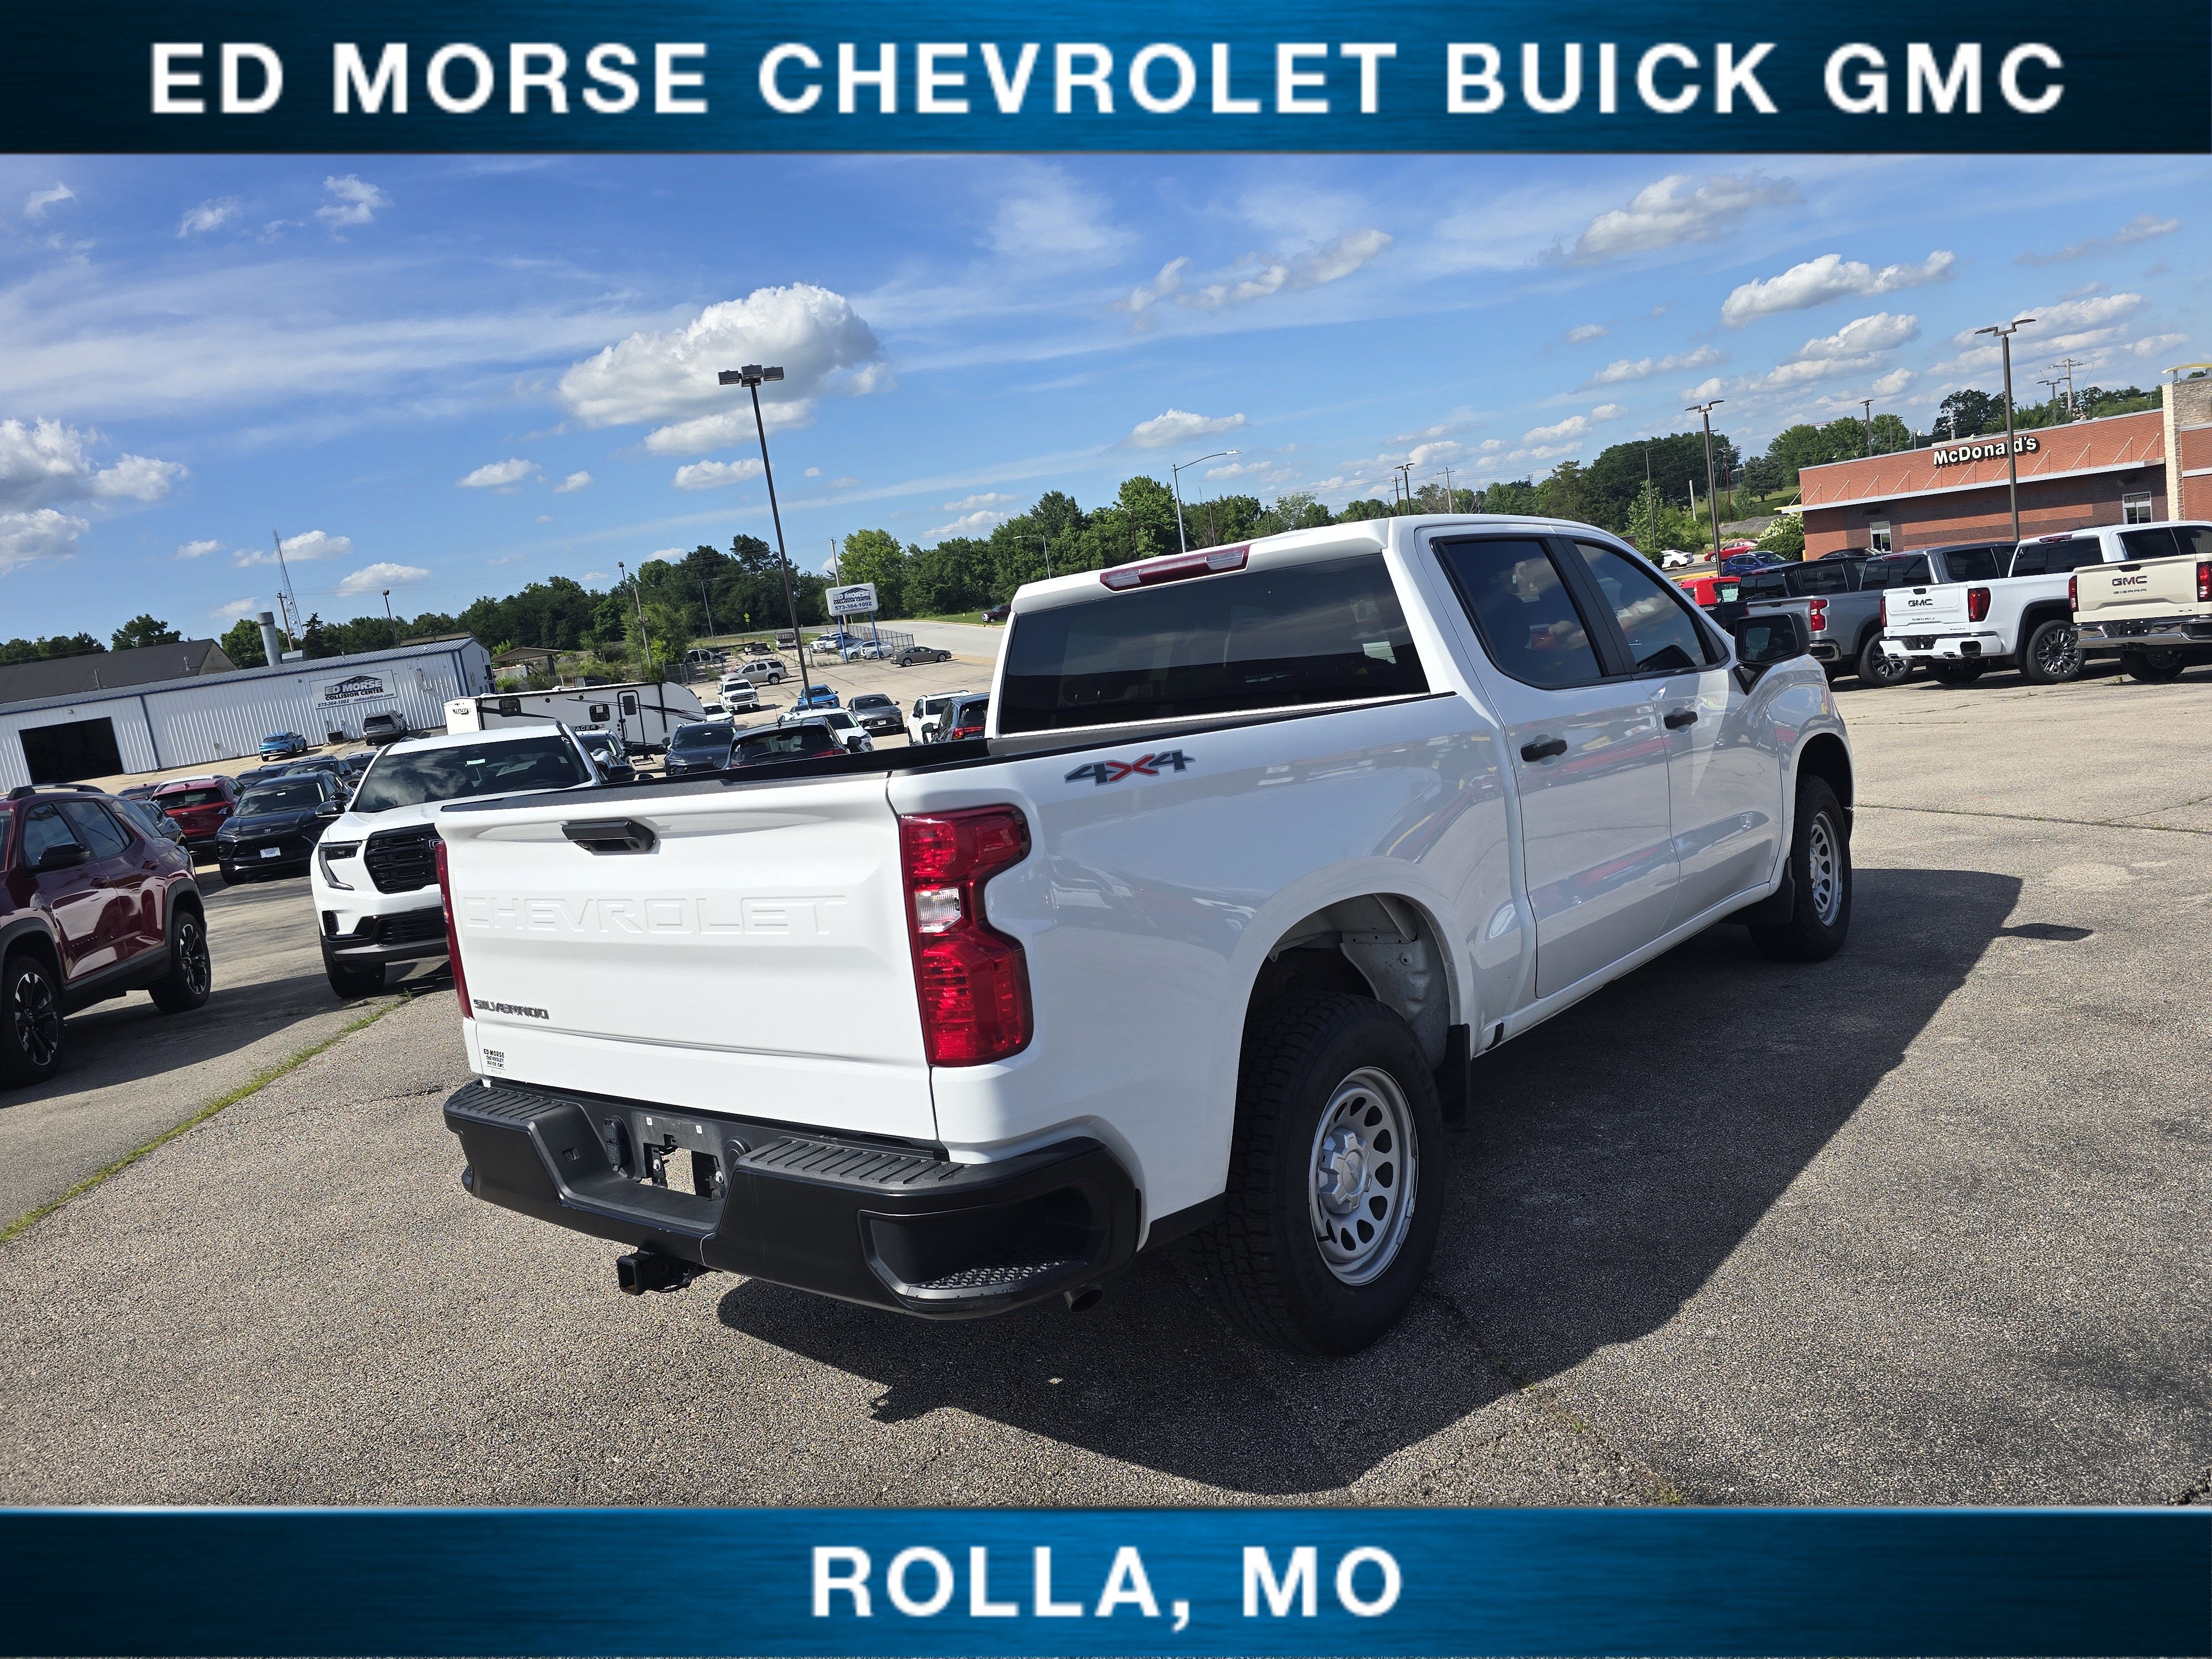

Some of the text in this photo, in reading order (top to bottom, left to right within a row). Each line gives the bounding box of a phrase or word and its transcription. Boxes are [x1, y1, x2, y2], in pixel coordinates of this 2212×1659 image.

[2112, 575, 2147, 587] GMC
[844, 589, 870, 599] MORSE
[834, 601, 872, 611] 573-364-1002
[1908, 598, 1933, 607] GMC
[325, 678, 383, 696] ED MORSE
[325, 688, 384, 701] COLLISION CENTER
[317, 698, 349, 708] 573-364-1002
[463, 894, 847, 935] CHEVROLET
[473, 999, 549, 1020] SILVERADO
[489, 1049, 505, 1058] MORSE
